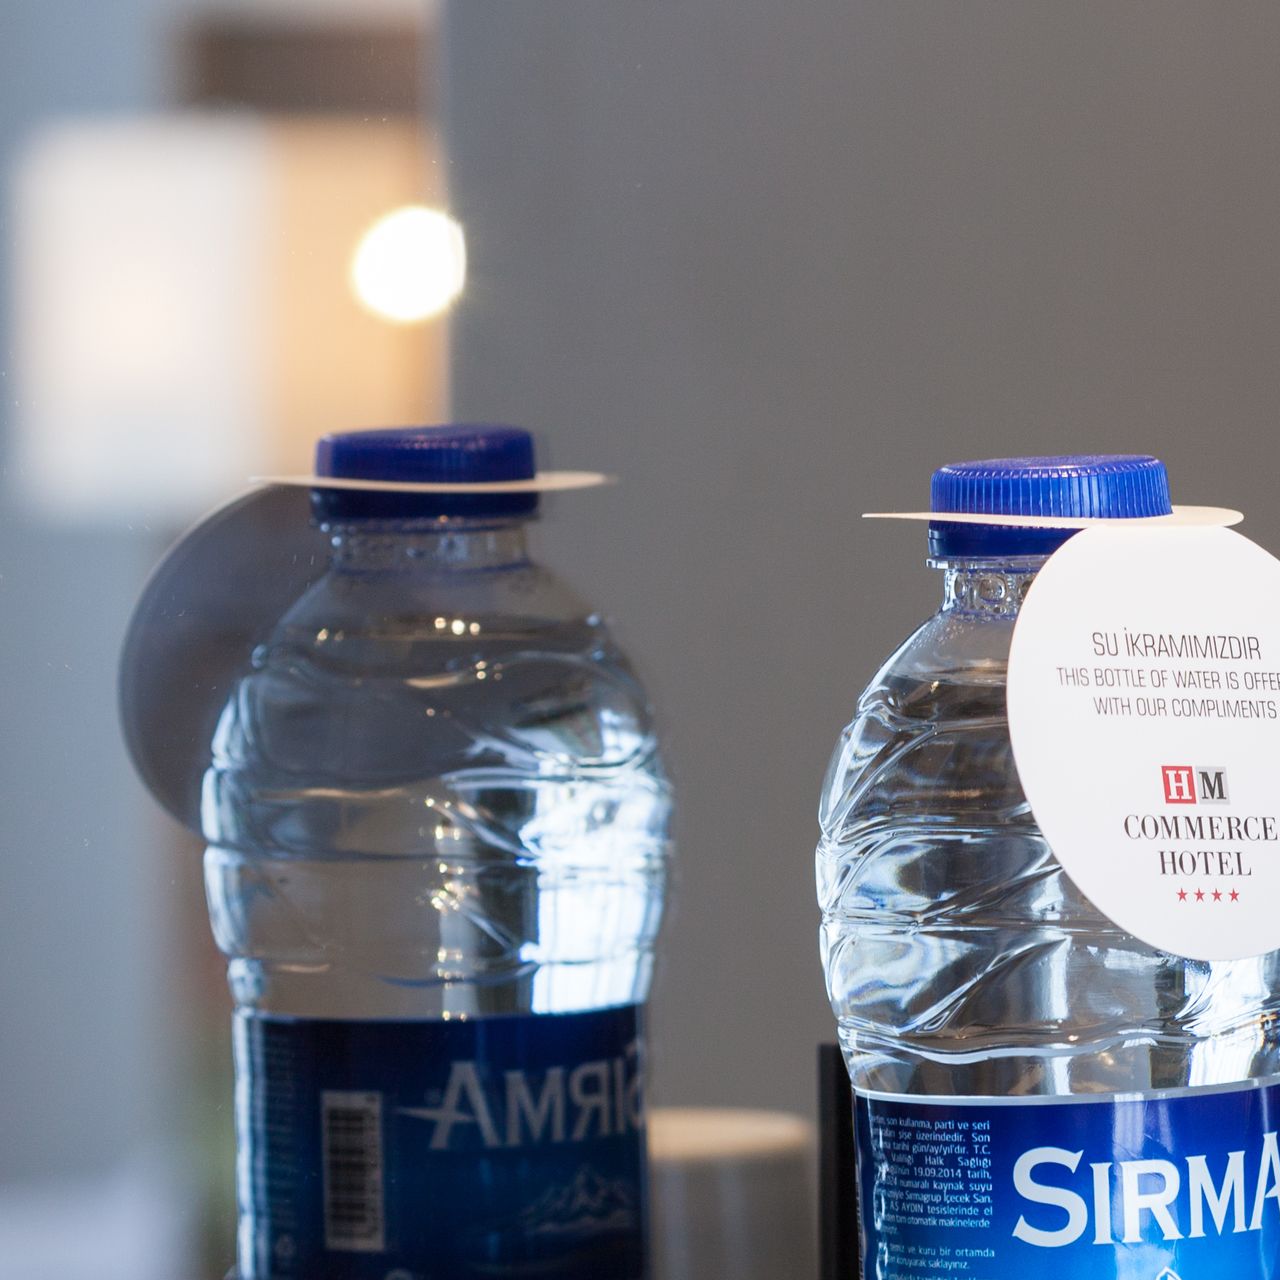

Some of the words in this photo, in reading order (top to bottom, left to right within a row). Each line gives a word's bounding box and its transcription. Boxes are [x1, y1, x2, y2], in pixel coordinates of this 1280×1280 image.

[1092, 632, 1118, 656] SU
[1123, 627, 1261, 660] İKRAMIMIZDIR
[1056, 667, 1089, 687] THIS
[1094, 668, 1147, 688] BOTTLE
[1150, 669, 1168, 688] OF
[1172, 670, 1221, 690] WATER
[1225, 671, 1240, 690] IS
[1093, 697, 1131, 716] WITH
[1136, 697, 1167, 717] OUR
[1171, 698, 1277, 719] COMPLIMENTS
[1124, 814, 1279, 841] COMMERCE
[1158, 850, 1252, 876] HOTEL
[934, 1120, 955, 1132] parti
[957, 1122, 969, 1130] ve
[972, 1120, 990, 1130] seri
[972, 1133, 991, 1143] Son
[924, 1156, 944, 1166] Halk
[913, 1167, 962, 1178] 19.09.2014
[933, 1180, 965, 1192] kaynak
[968, 1183, 993, 1193] suyu
[955, 1248, 995, 1258] ortamda
